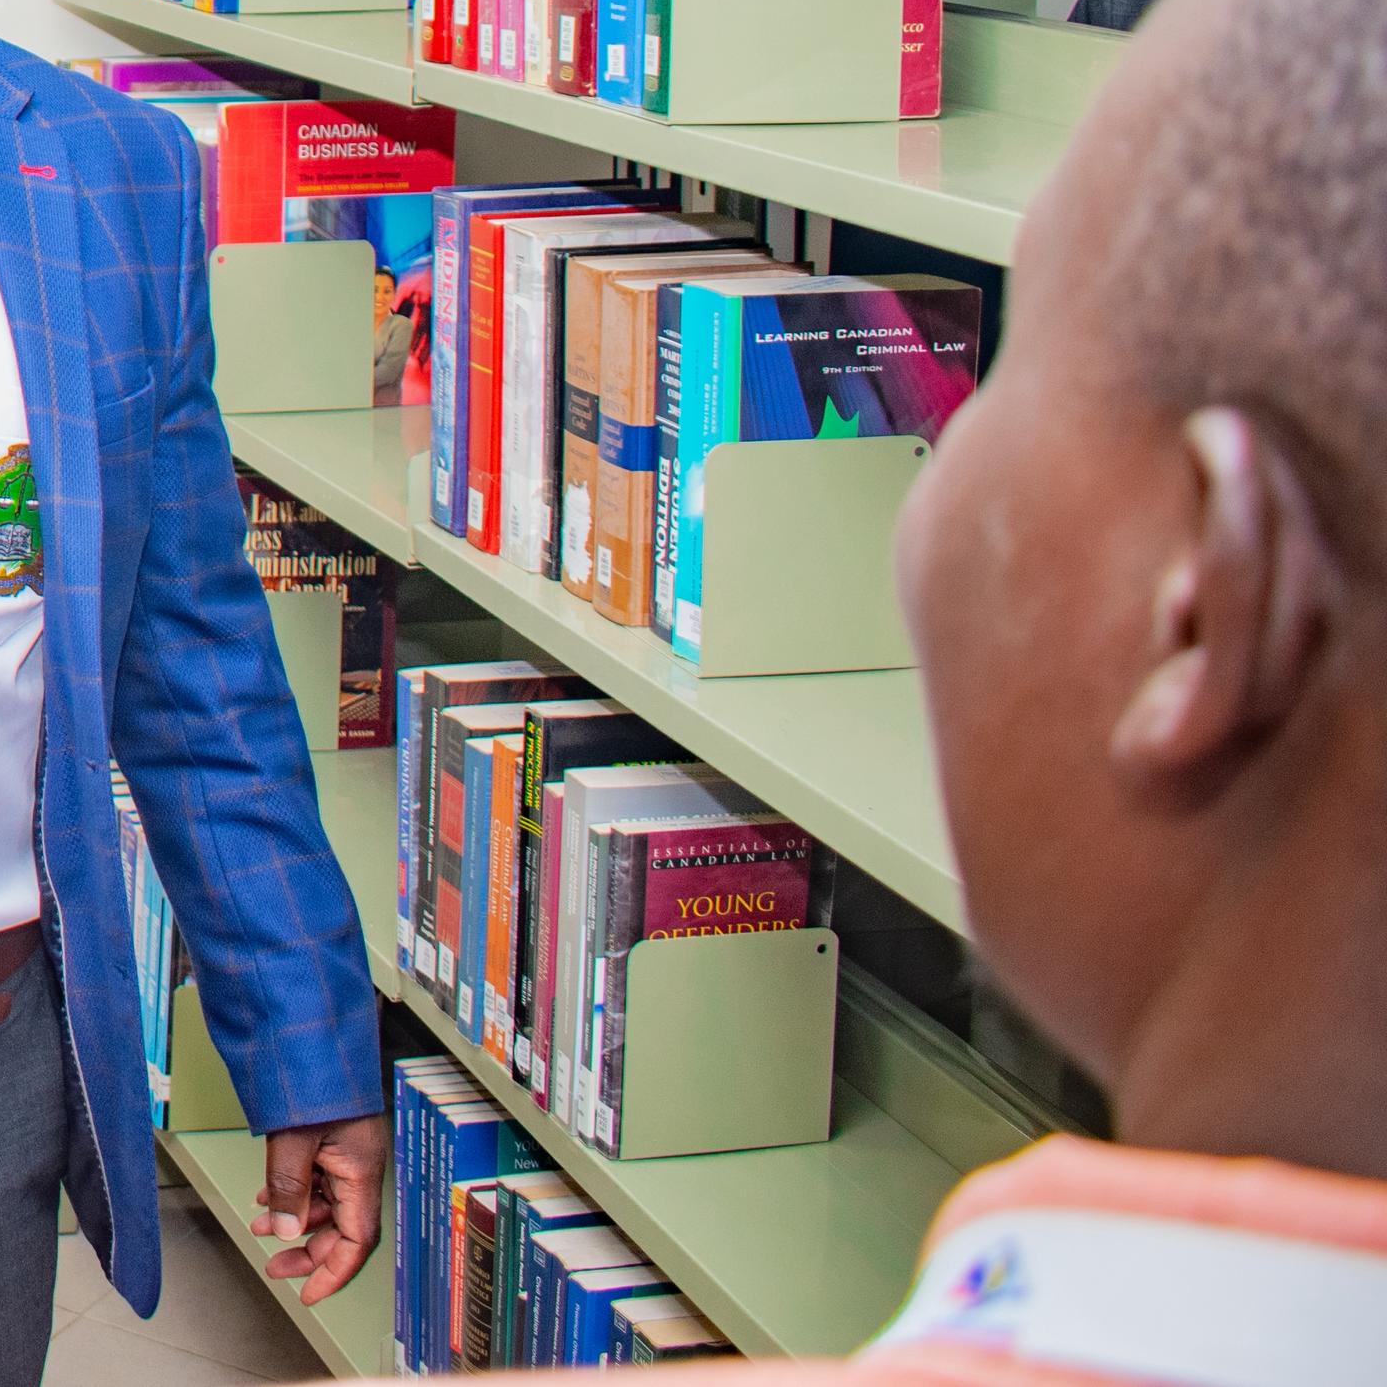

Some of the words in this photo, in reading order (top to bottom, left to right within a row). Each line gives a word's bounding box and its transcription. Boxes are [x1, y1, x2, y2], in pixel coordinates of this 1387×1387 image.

[298, 123, 379, 140] CANADIAN
[298, 142, 379, 159] BUSINESS
[383, 141, 417, 156] LAW
[299, 173, 314, 181] The
[316, 173, 354, 181] Business
[442, 218, 457, 350] EVIDENCE
[251, 493, 297, 524] Law
[654, 456, 669, 567] EDITION
[668, 457, 680, 574] STUDENT
[430, 707, 438, 747] LEARNING
[534, 726, 543, 781] CRIMINAL
[400, 737, 411, 813] CRIMINAL
[400, 817, 410, 851] LAW
[653, 839, 771, 858] ESSENTIALS
[785, 837, 811, 849] OF
[490, 818, 502, 883] Criminal
[502, 825, 513, 889] Criminal
[651, 853, 756, 870] CANADIAN
[770, 849, 807, 861] LAW
[489, 886, 500, 916] Law
[501, 894, 511, 924] Law
[677, 891, 776, 919] YOUNG
[514, 1158, 540, 1170] New
[532, 1295, 541, 1335] Litigation
